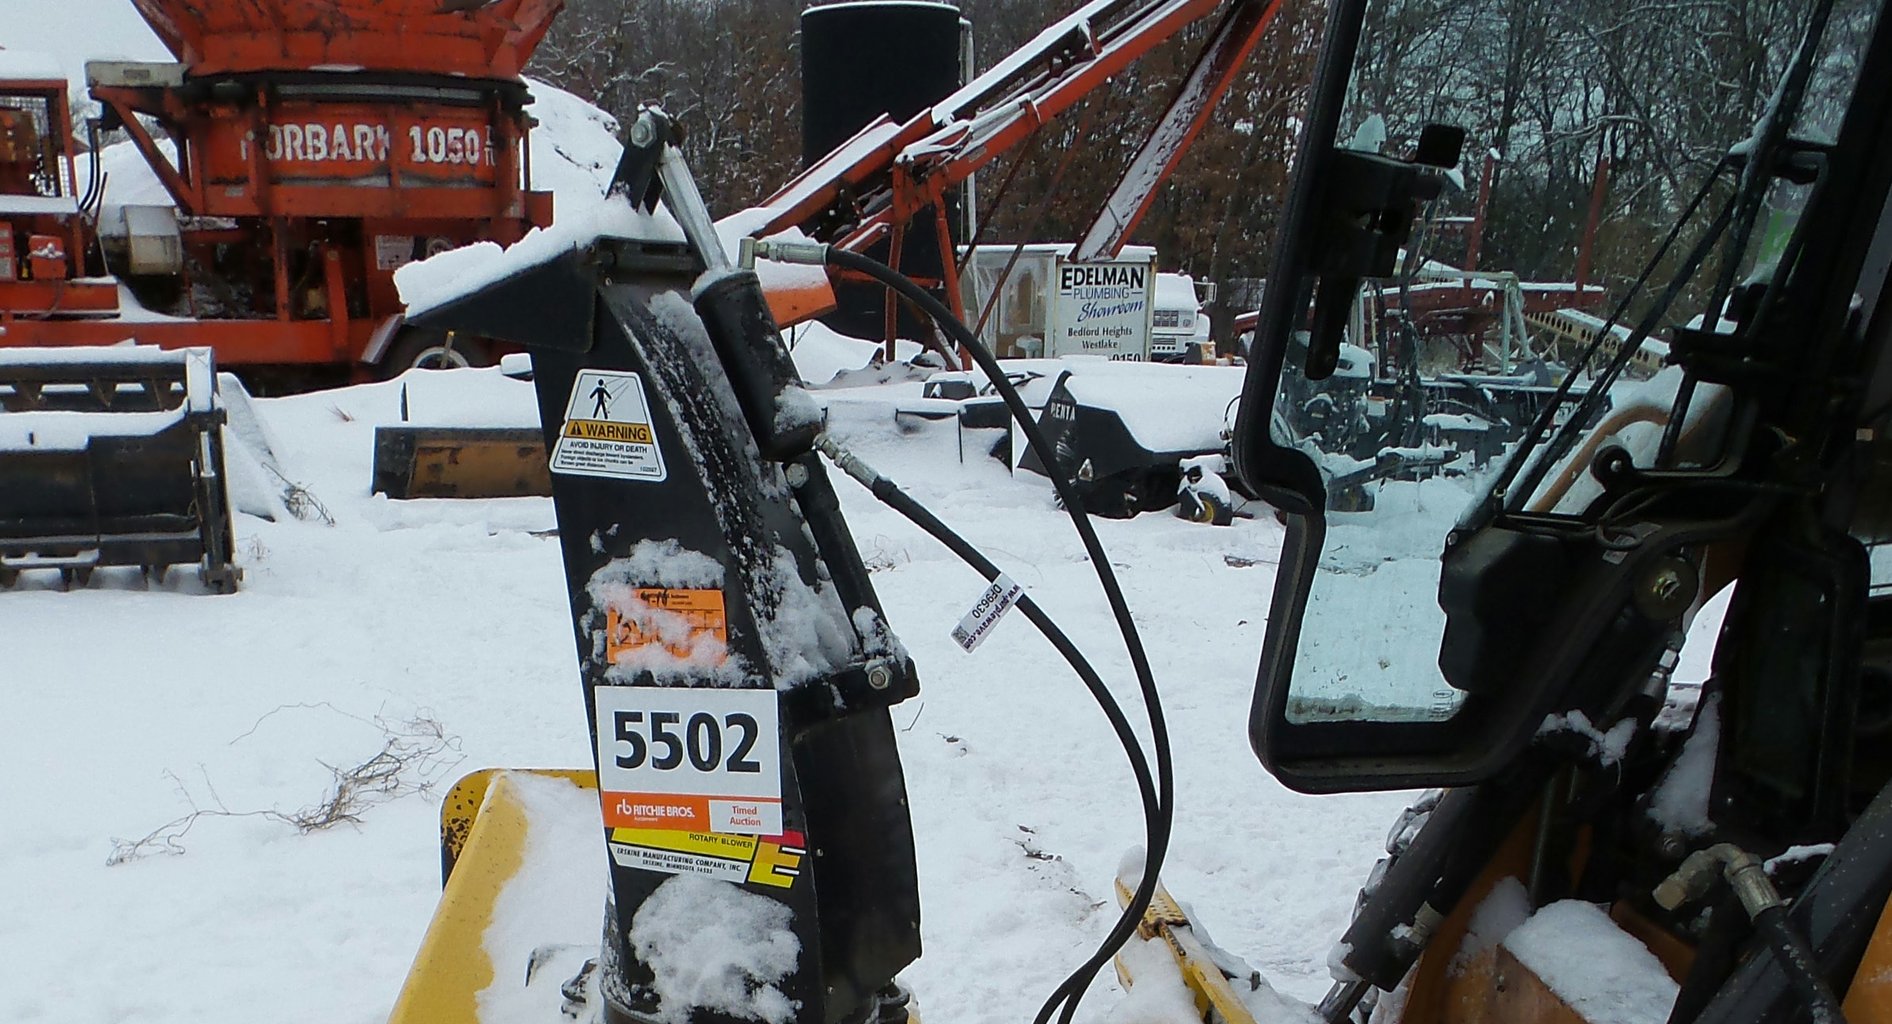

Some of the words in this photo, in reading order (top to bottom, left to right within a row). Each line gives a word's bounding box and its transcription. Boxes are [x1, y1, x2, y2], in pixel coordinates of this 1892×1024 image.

[408, 125, 480, 164] 1050
[1061, 267, 1144, 290] EDELMAN
[1073, 287, 1130, 300] PLUMBING
[1077, 300, 1144, 322] Showroom
[1068, 326, 1099, 337] Bedford
[1102, 326, 1132, 338] Heights
[1082, 340, 1118, 349] Westlake
[586, 423, 647, 440] WARNING
[570, 441, 589, 449] AVOID
[614, 444, 625, 452] OR
[625, 445, 648, 453] DEATH
[971, 583, 1003, 619] DF9630
[613, 710, 761, 773] 5502
[633, 804, 665, 817] RITCHIE
[666, 806, 696, 818] BROS.
[731, 805, 758, 815] Timed
[729, 816, 761, 827] Auction
[688, 833, 718, 843] ROTARY
[721, 838, 753, 849] BLOWER
[617, 847, 640, 858] ERSKINE
[642, 851, 694, 865] MANUFACTURING
[695, 858, 727, 870] COMPANY,
[729, 864, 742, 872] INC.
[666, 863, 695, 872] MINNESOTA
